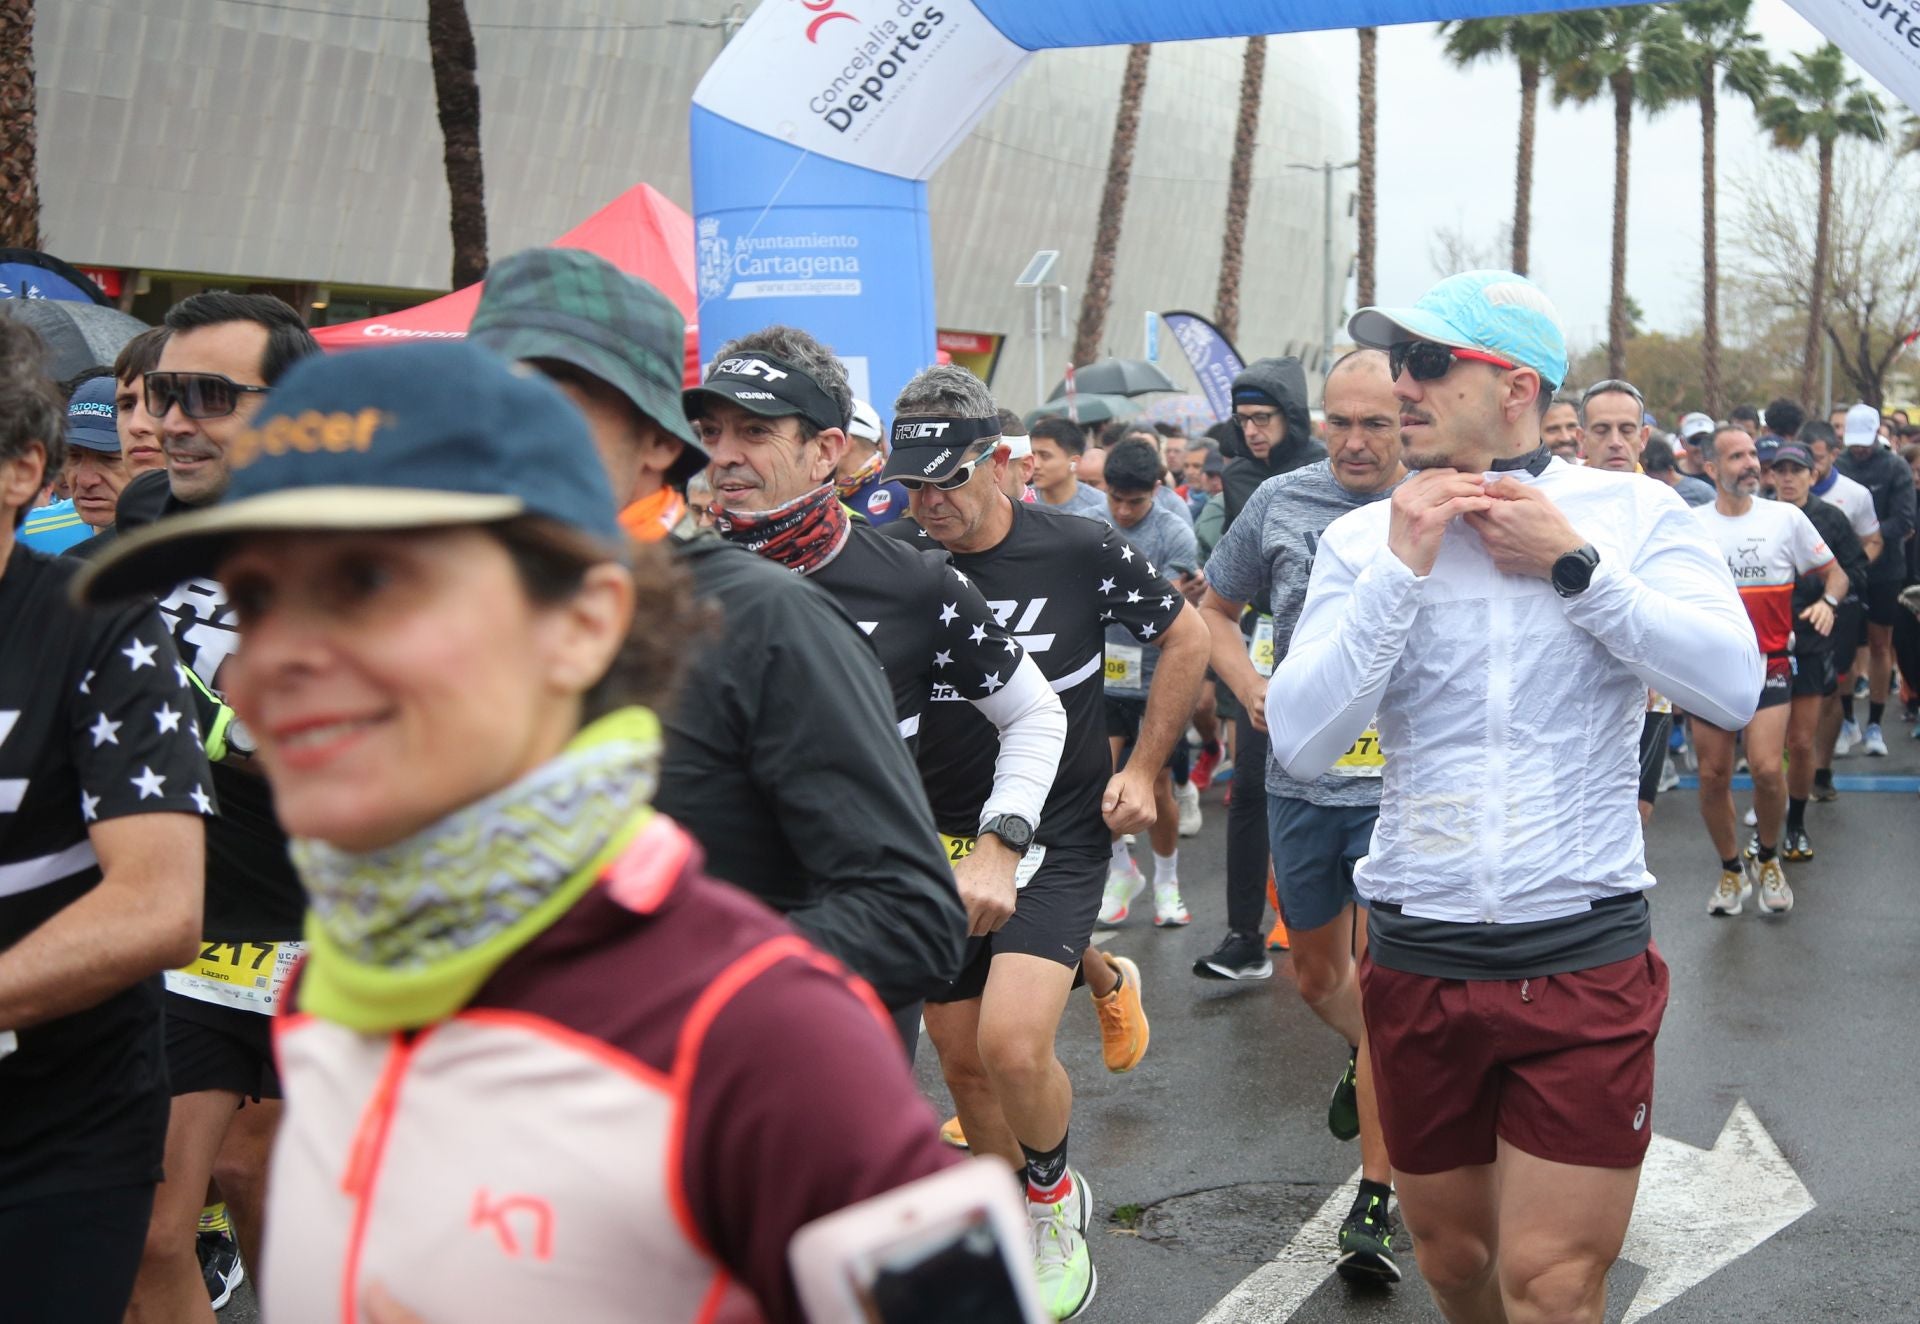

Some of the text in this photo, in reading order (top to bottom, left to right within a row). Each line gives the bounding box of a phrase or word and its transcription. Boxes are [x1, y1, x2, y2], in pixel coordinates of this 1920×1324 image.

[1861, 0, 1920, 48] orte
[824, 6, 945, 133] Deportes
[734, 232, 859, 254] Ayuntamiento
[735, 253, 860, 279] Cartagena
[756, 281, 857, 294] www.cartagena.es
[363, 323, 468, 338] Cronom
[1731, 565, 1767, 578] NERS
[986, 598, 1048, 632] RI
[1107, 662, 1126, 674] 08
[199, 941, 275, 970] 217
[278, 952, 298, 961] UCA
[201, 967, 230, 981] Lazaro
